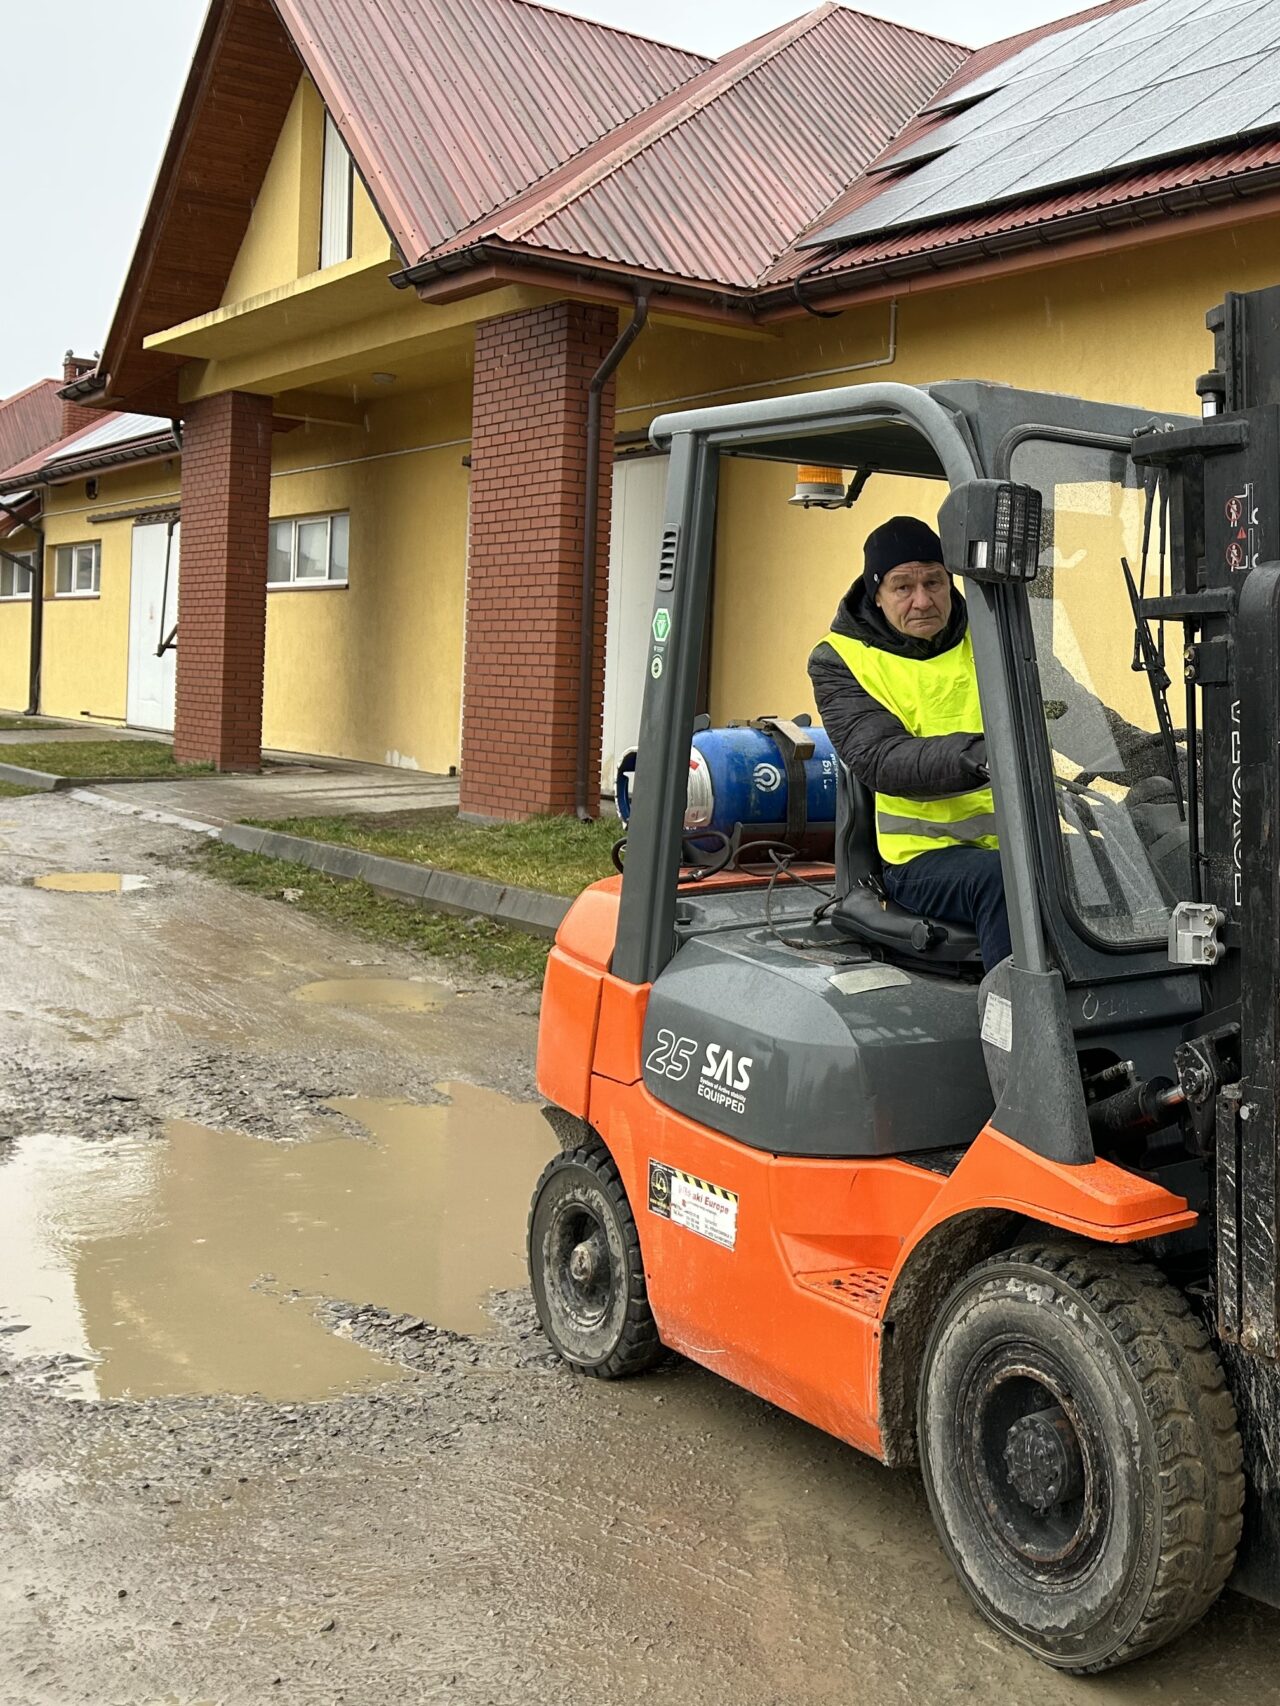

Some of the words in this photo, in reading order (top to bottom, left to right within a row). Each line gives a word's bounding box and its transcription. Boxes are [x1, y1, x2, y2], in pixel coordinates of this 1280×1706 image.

[645, 1028, 698, 1081] 25
[701, 1043, 753, 1091] SAS
[697, 1083, 745, 1114] EQUIPPED
